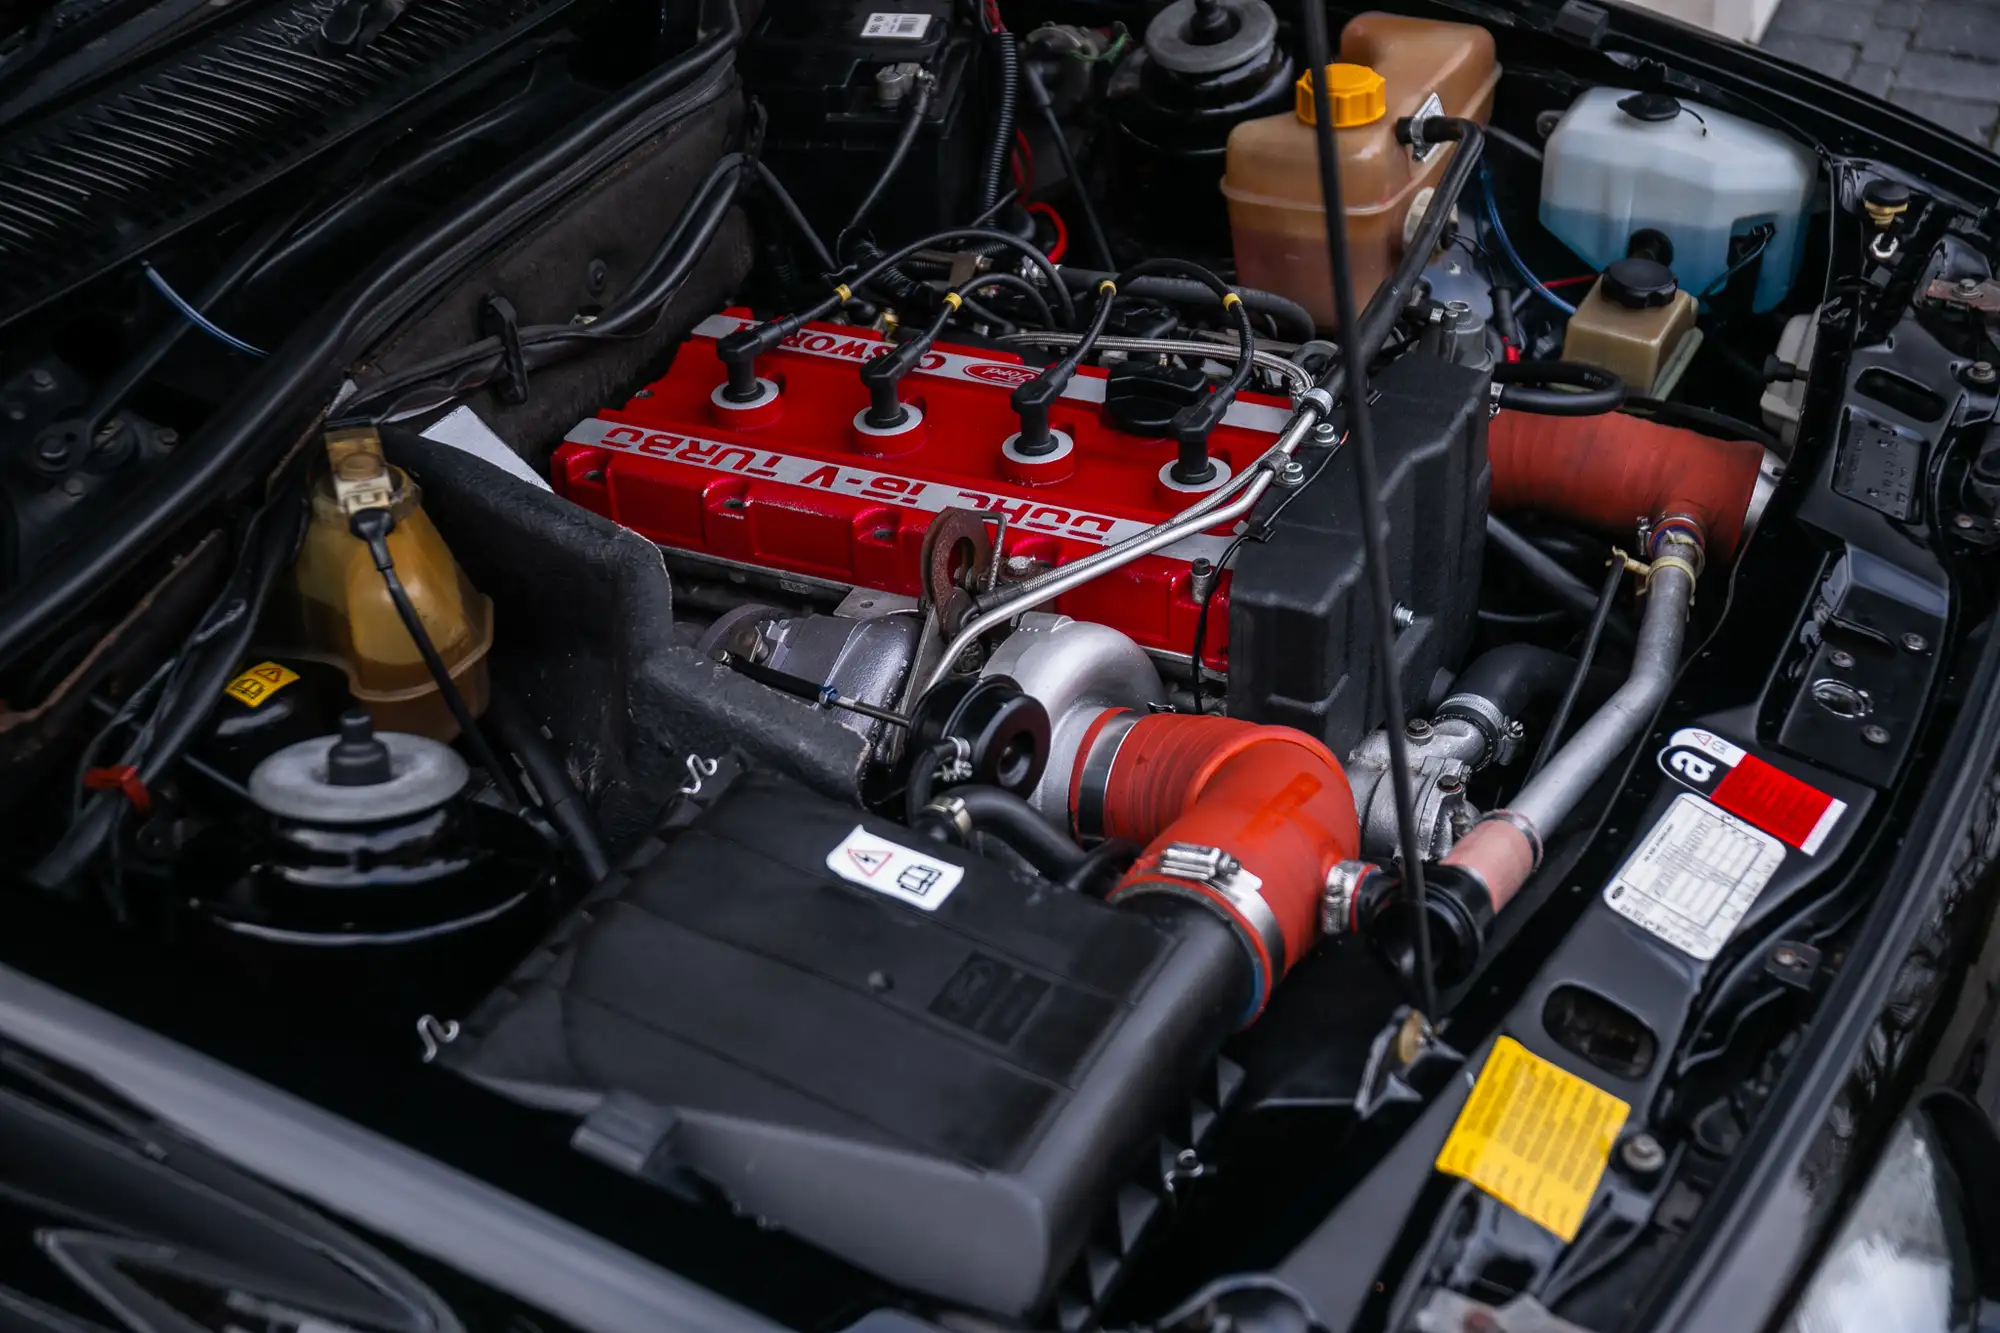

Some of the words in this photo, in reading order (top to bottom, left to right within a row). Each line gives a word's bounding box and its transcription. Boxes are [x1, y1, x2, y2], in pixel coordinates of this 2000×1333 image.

[981, 367, 1036, 383] Ford
[600, 426, 784, 478] TURBO
[1670, 750, 1717, 783] a
